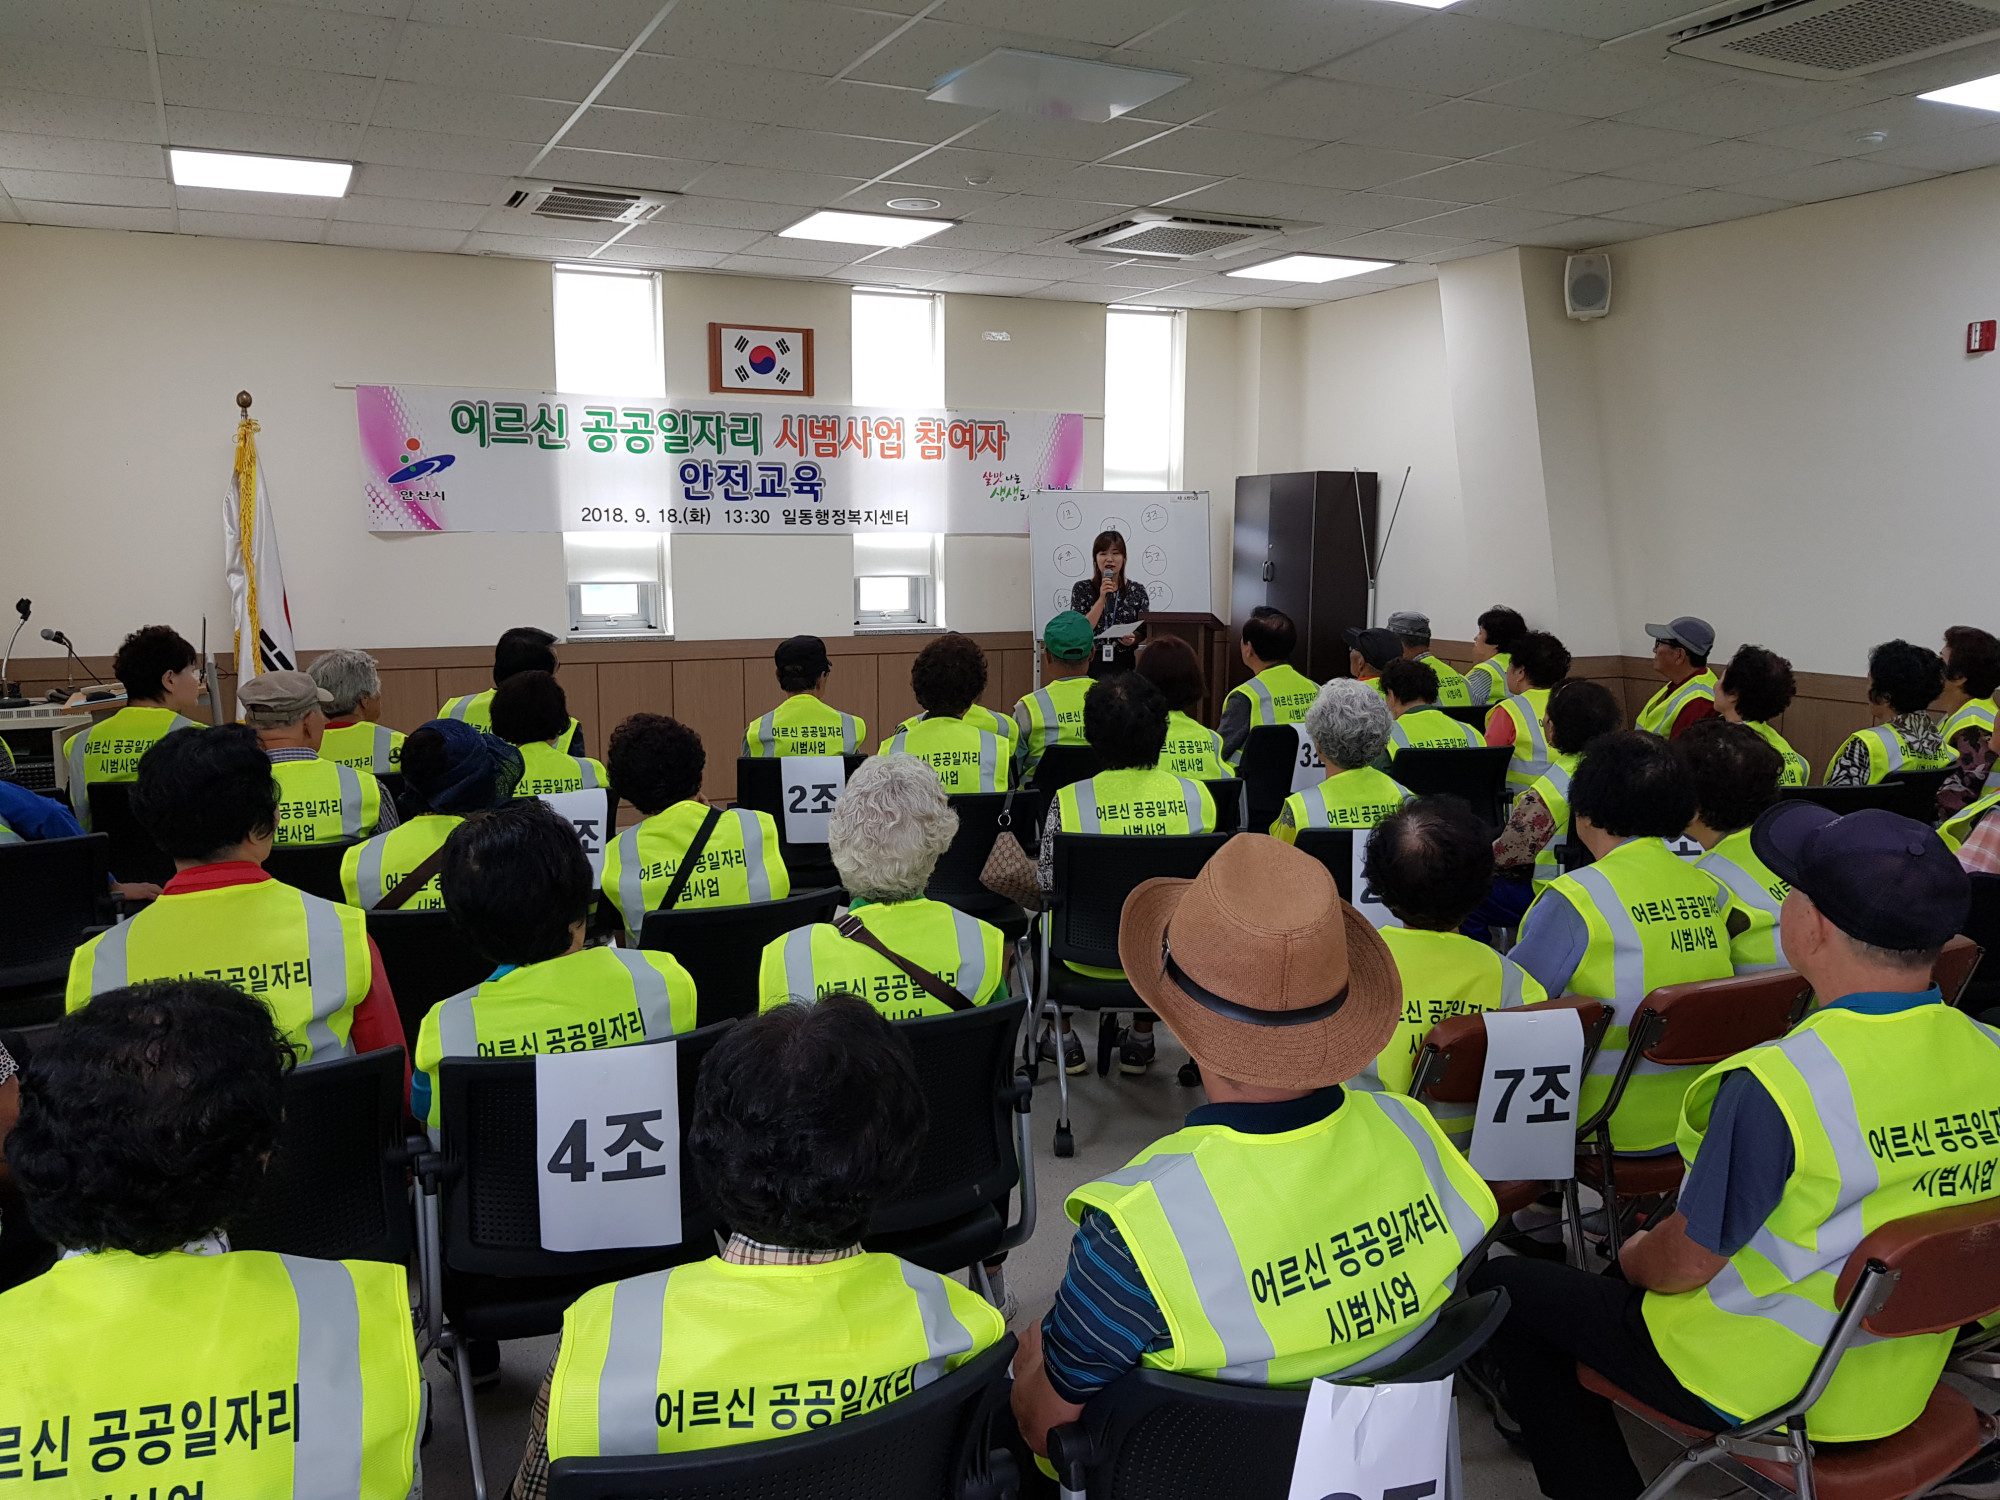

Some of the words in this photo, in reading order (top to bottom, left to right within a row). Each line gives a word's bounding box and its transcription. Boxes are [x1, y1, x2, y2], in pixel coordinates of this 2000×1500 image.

[450, 400, 570, 450] 어르신
[579, 405, 763, 456] 공공일자리
[773, 413, 906, 461] 시범사업
[914, 417, 1010, 462] 참여자
[677, 459, 827, 503] 안전교육
[990, 485, 1029, 502] 생생도
[400, 490, 446, 501] 안산시
[581, 507, 628, 523] 2018.
[635, 508, 650, 523] 9.
[658, 508, 711, 525] 18.(화)
[724, 509, 770, 524] 13:30
[783, 509, 909, 525] 일동행정복지센터
[1274, 694, 1293, 707] 어르신
[1058, 711, 1081, 724] 어르신
[771, 726, 798, 738] 어르신
[800, 726, 844, 738] 공공일자리
[85, 740, 111, 755] 어르신
[790, 741, 826, 754] 시범사업
[932, 751, 980, 767] 공공일자리
[100, 758, 139, 773] 시범사업
[938, 770, 959, 785] 사업
[1171, 758, 1204, 772] 시범사업
[532, 778, 584, 795] 공공일자리
[787, 783, 837, 814] 2조
[280, 798, 343, 819] 공공일자리
[1095, 802, 1130, 821] 어르신
[1133, 799, 1189, 819] 공공일자리
[1326, 806, 1360, 825] 어르신
[573, 819, 600, 854] 조
[638, 859, 676, 881] 어르신
[688, 848, 747, 873] 공일자리
[676, 877, 720, 903] 범사업
[1631, 898, 1677, 924] 어르신
[1671, 926, 1718, 953] 시범사업
[546, 1007, 647, 1054] 공공일자리
[1492, 1065, 1571, 1124] 7조
[546, 1109, 667, 1182] 4조
[1868, 1120, 1936, 1163] 어르신
[1934, 1107, 2000, 1152] 공공일자
[1912, 1157, 1998, 1197] 시범사업
[1252, 1242, 1332, 1307] 어르신
[1330, 1193, 1448, 1277] 공공일자리
[1326, 1271, 1420, 1345] 시범사업
[655, 1387, 755, 1433] 어르신
[769, 1363, 917, 1431] 공공일자리
[0, 1415, 70, 1481] 르신
[88, 1382, 300, 1473] 공공일자리
